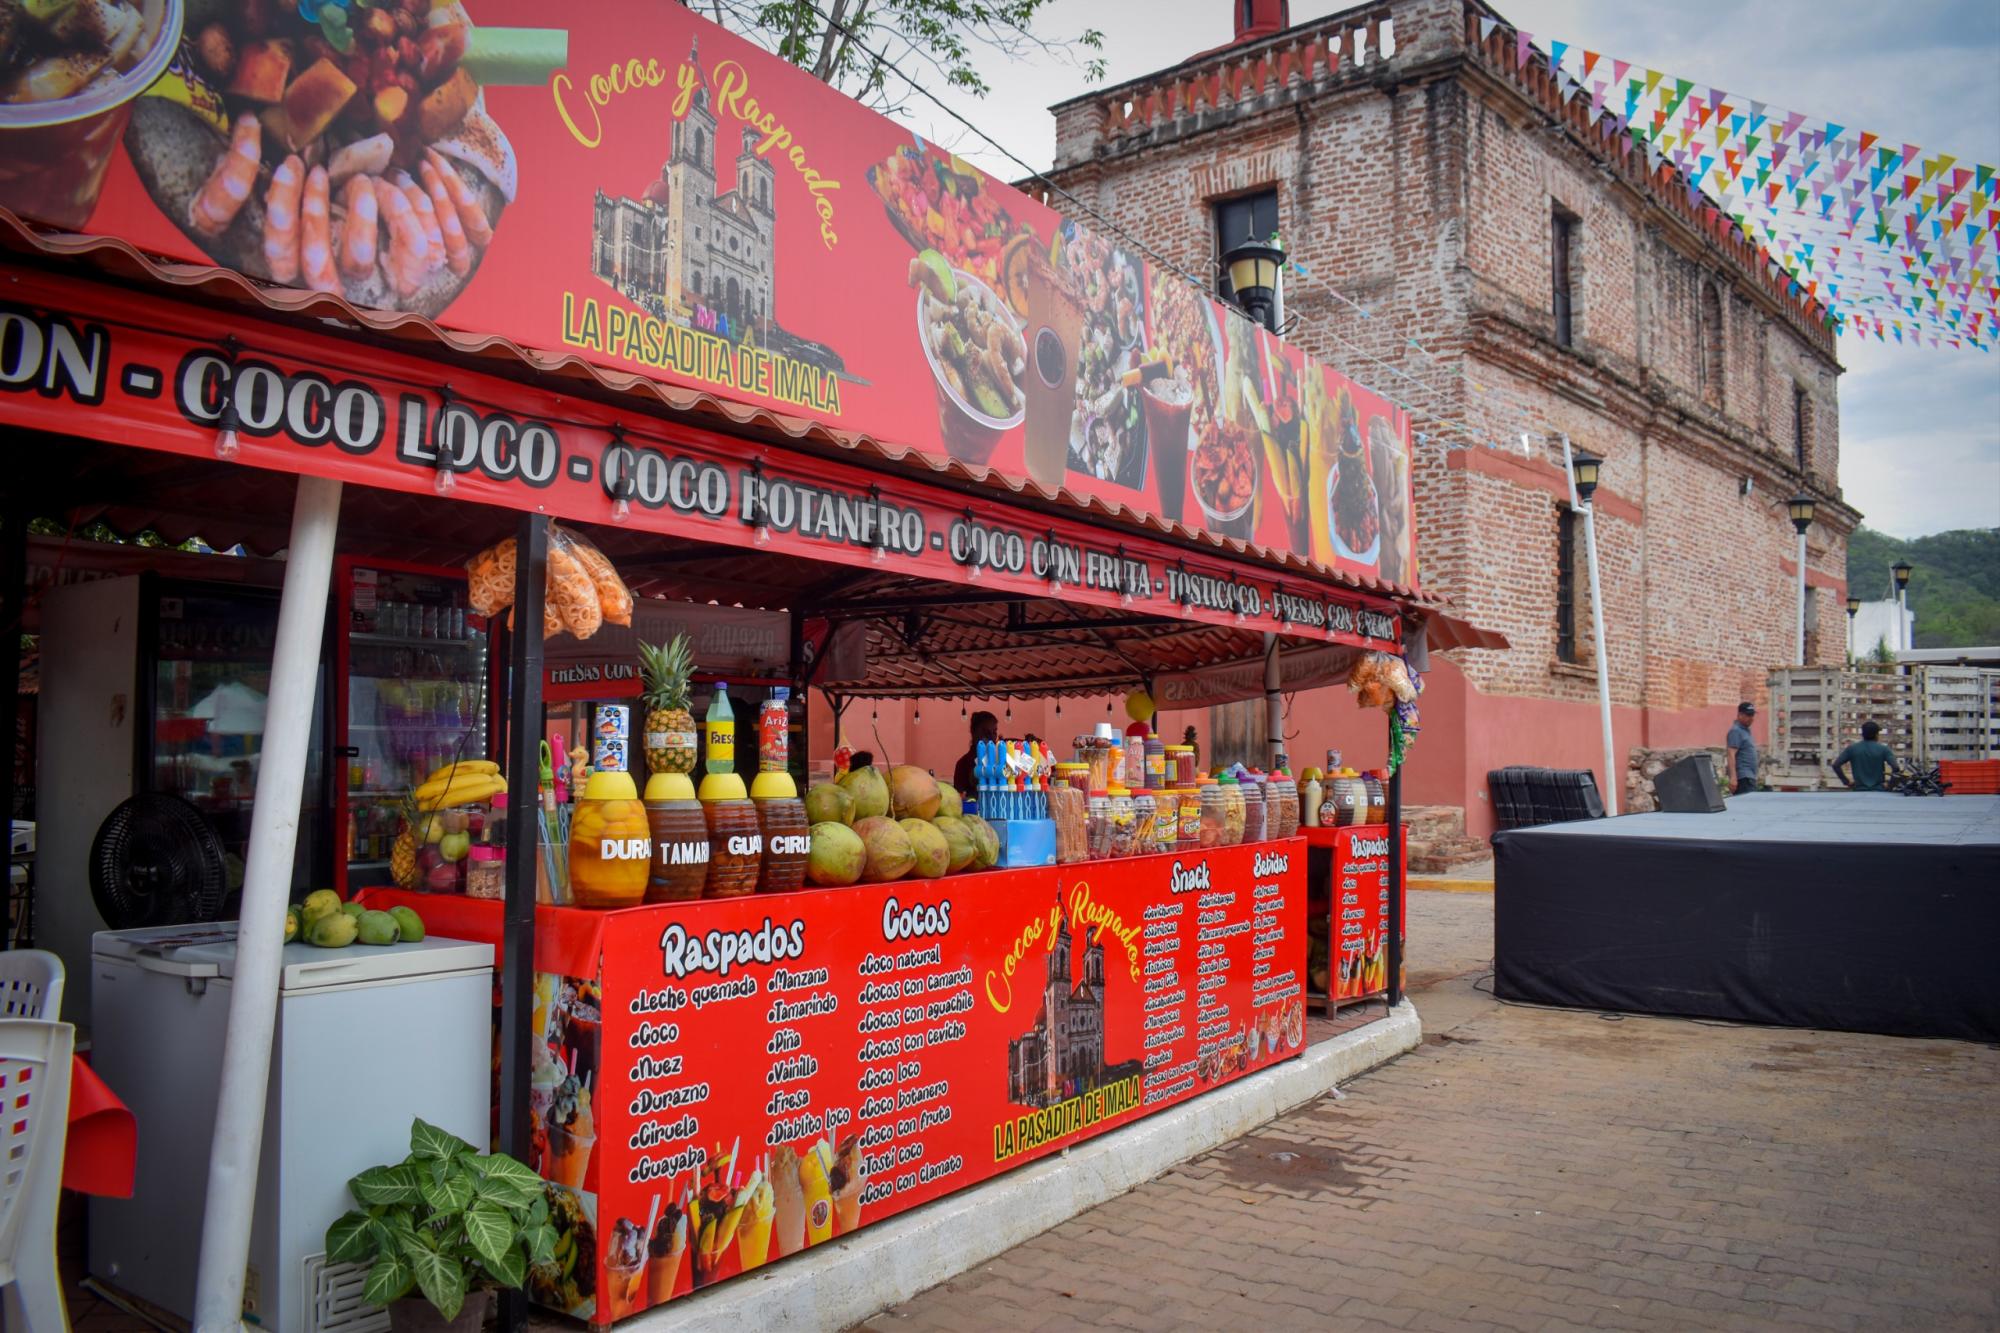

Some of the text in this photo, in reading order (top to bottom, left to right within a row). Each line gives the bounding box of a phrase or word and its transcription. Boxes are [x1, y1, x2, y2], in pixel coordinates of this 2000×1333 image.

[553, 56, 841, 251] Cocos y Raspados
[562, 292, 841, 416] LA PASADITA DE IMALA
[180, 354, 382, 450] COCO
[401, 400, 560, 483] LOCO
[603, 446, 730, 515] COCO
[742, 475, 925, 553] BOTANERO
[950, 522, 1025, 572] COCO
[1031, 540, 1080, 583] CON
[1086, 552, 1151, 596] FRUTA
[1166, 569, 1261, 615] TOSTICOCO
[1273, 592, 1325, 627] FRESAS
[1327, 603, 1353, 633] CON
[1356, 610, 1396, 640] CREMA
[601, 837, 651, 860] DURA
[728, 834, 762, 855] GUA
[770, 835, 811, 854] CIRU
[1351, 834, 1389, 859] Raspados
[1171, 860, 1211, 894] Snack
[1253, 851, 1289, 878] Bebidas
[882, 897, 950, 941] Cocos
[661, 917, 804, 978] Raspados
[866, 944, 940, 973] Coco natural
[985, 881, 1142, 1013] Cocos y Raspados
[1147, 941, 1164, 956] Papas
[640, 975, 757, 1012] Leche quemada
[775, 968, 828, 990] Manzana
[866, 965, 973, 1003] Cocos con camarón
[775, 994, 837, 1022] Tamarindo
[866, 991, 974, 1032] Cocos con aguachile
[640, 1022, 678, 1046] Coco
[775, 1030, 801, 1052] Piña
[866, 1022, 966, 1061] Cocos con ceviche
[640, 1055, 682, 1078] Nuez
[774, 1054, 818, 1083] Vainilla
[866, 1061, 920, 1090] Coco loco
[640, 1083, 709, 1114] Durazno
[774, 1090, 809, 1115] Fresa
[866, 1080, 948, 1119] Coco botanero
[640, 1114, 697, 1147] Ciruela
[774, 1107, 850, 1144] Diablito loco
[866, 1106, 951, 1148] Coco con fruta
[994, 1120, 1015, 1163] LA
[1017, 1097, 1082, 1154] PASADITA
[1084, 1089, 1102, 1128] DE
[1103, 1075, 1141, 1119] IMALA
[640, 1147, 706, 1181] Guayaba
[865, 1141, 923, 1176] Tosti coco
[866, 1154, 962, 1204] Coco con clamato
